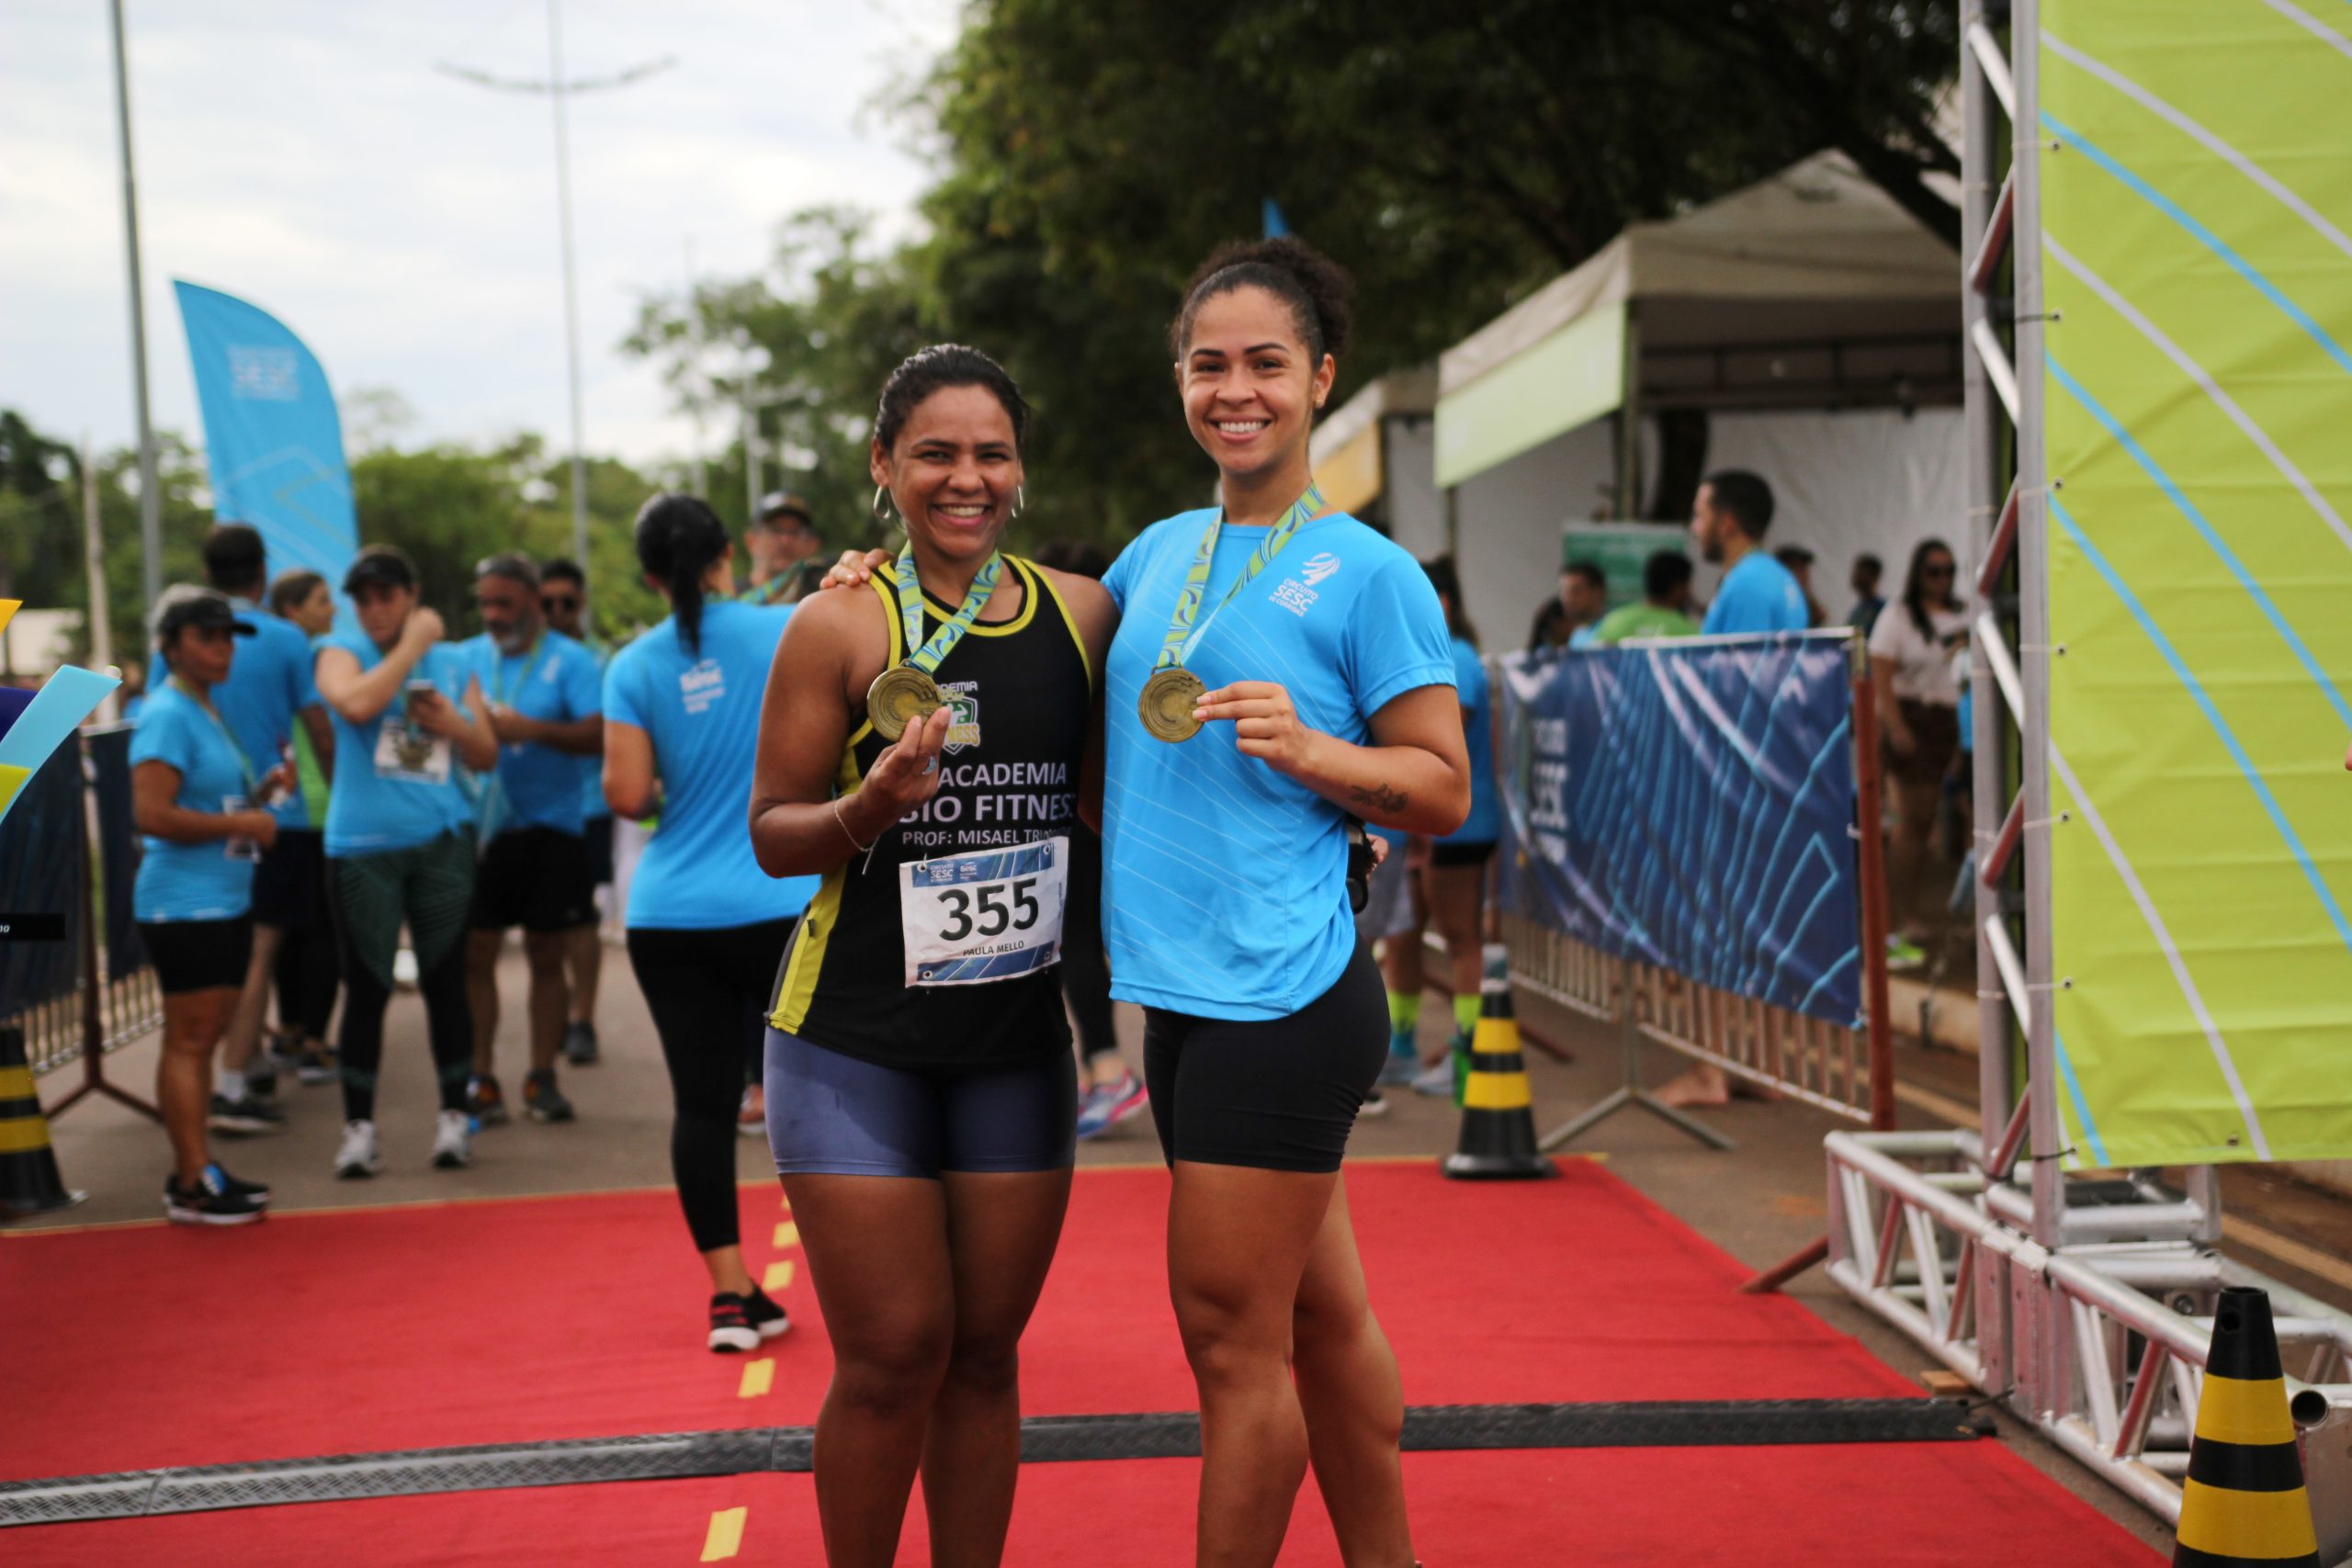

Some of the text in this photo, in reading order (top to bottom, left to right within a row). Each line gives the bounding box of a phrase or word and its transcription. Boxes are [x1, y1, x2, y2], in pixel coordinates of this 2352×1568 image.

[1273, 584, 1314, 612] SESC
[947, 723, 980, 746] NESS
[938, 762, 1067, 788] ACADEMIA
[976, 793, 1076, 821] FITNES
[902, 830, 952, 847] PROF:
[958, 829, 1020, 844] MISAEL
[930, 869, 954, 878] SESC
[936, 877, 1039, 942] 355
[963, 941, 1024, 956] PAULA MELLO
